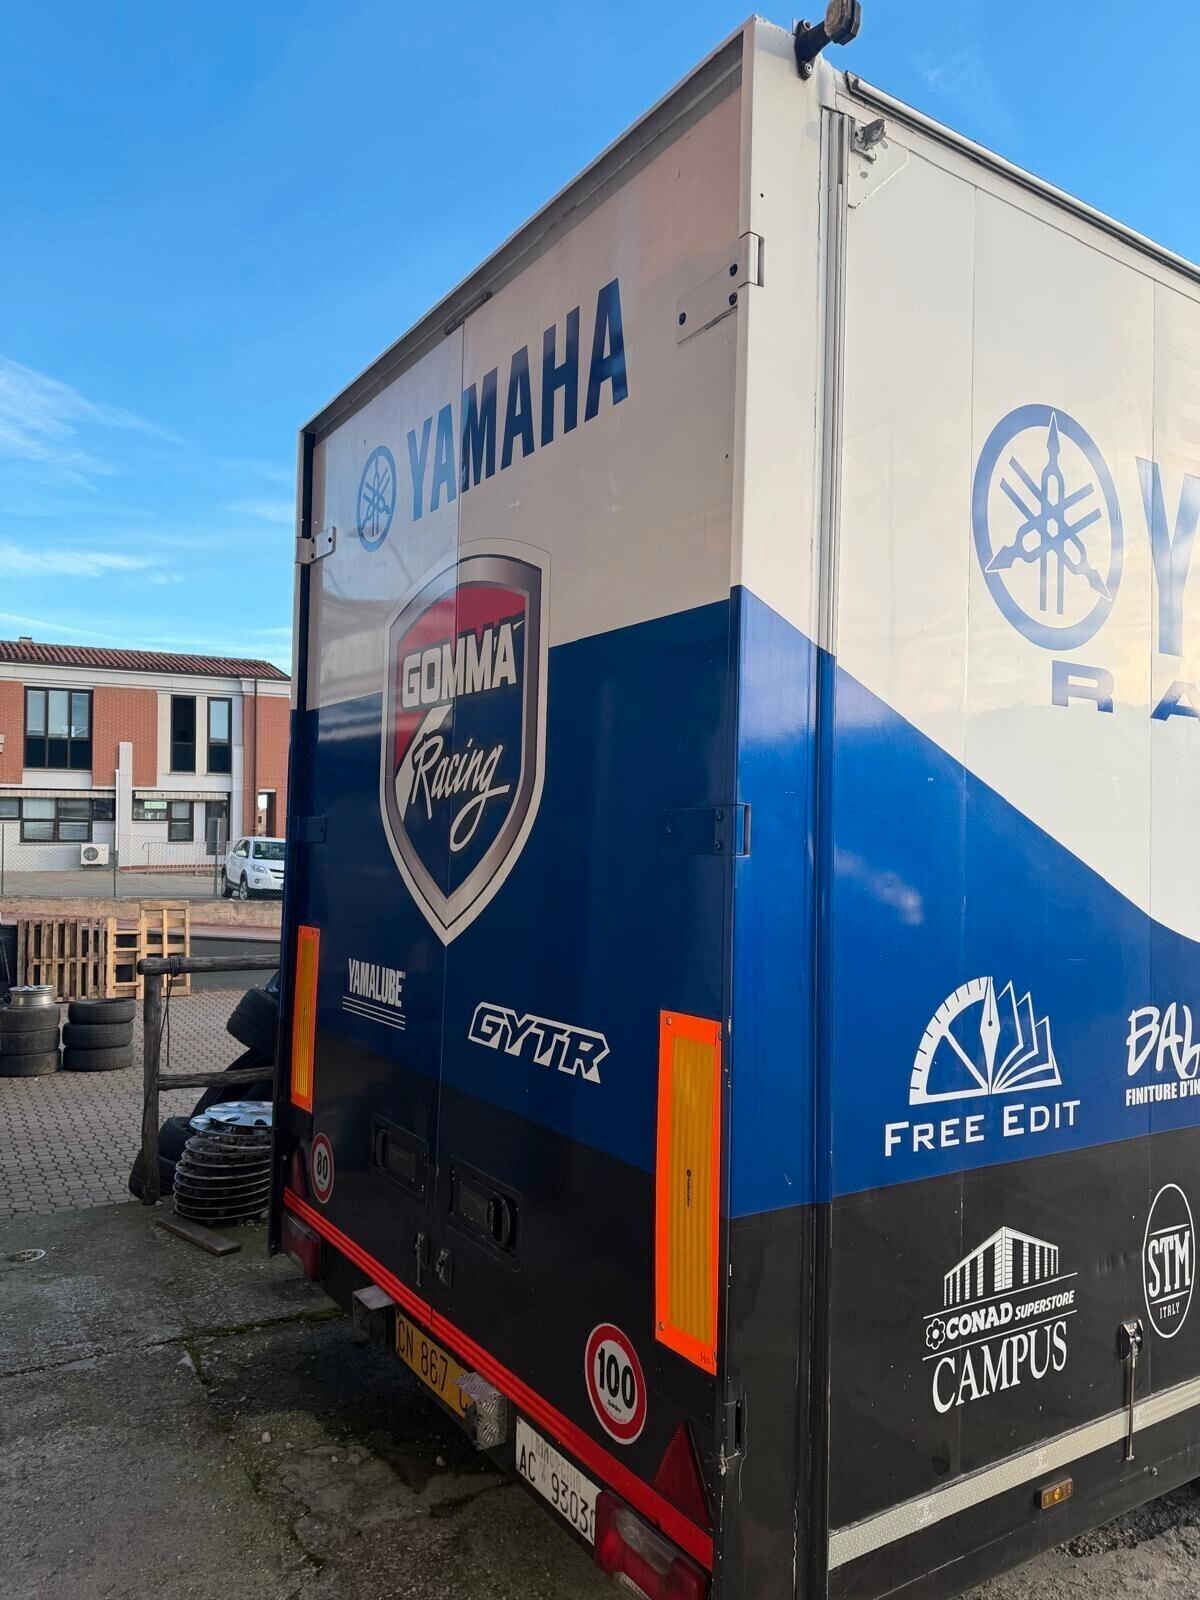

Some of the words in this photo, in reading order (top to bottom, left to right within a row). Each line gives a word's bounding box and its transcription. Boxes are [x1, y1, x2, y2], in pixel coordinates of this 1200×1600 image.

[406, 277, 629, 522] YAMAHA
[402, 622, 517, 708] GOMMA
[411, 737, 511, 852] Racing
[467, 1001, 610, 1084] GYTR
[1125, 1082, 1178, 1107] FINITURE
[884, 1114, 985, 1157] FREE
[1003, 1099, 1081, 1138] EDIT
[316, 1150, 330, 1181] 80
[1148, 1230, 1191, 1298] STM
[945, 1301, 1014, 1340] CONAD
[1014, 1289, 1076, 1320] SUPERSTORE
[1159, 1301, 1180, 1320] ITALY
[398, 1319, 414, 1362] CN
[421, 1341, 449, 1392] 867
[597, 1346, 637, 1410] 100
[932, 1320, 1068, 1414] CAMPUS
[519, 1443, 537, 1482] AC
